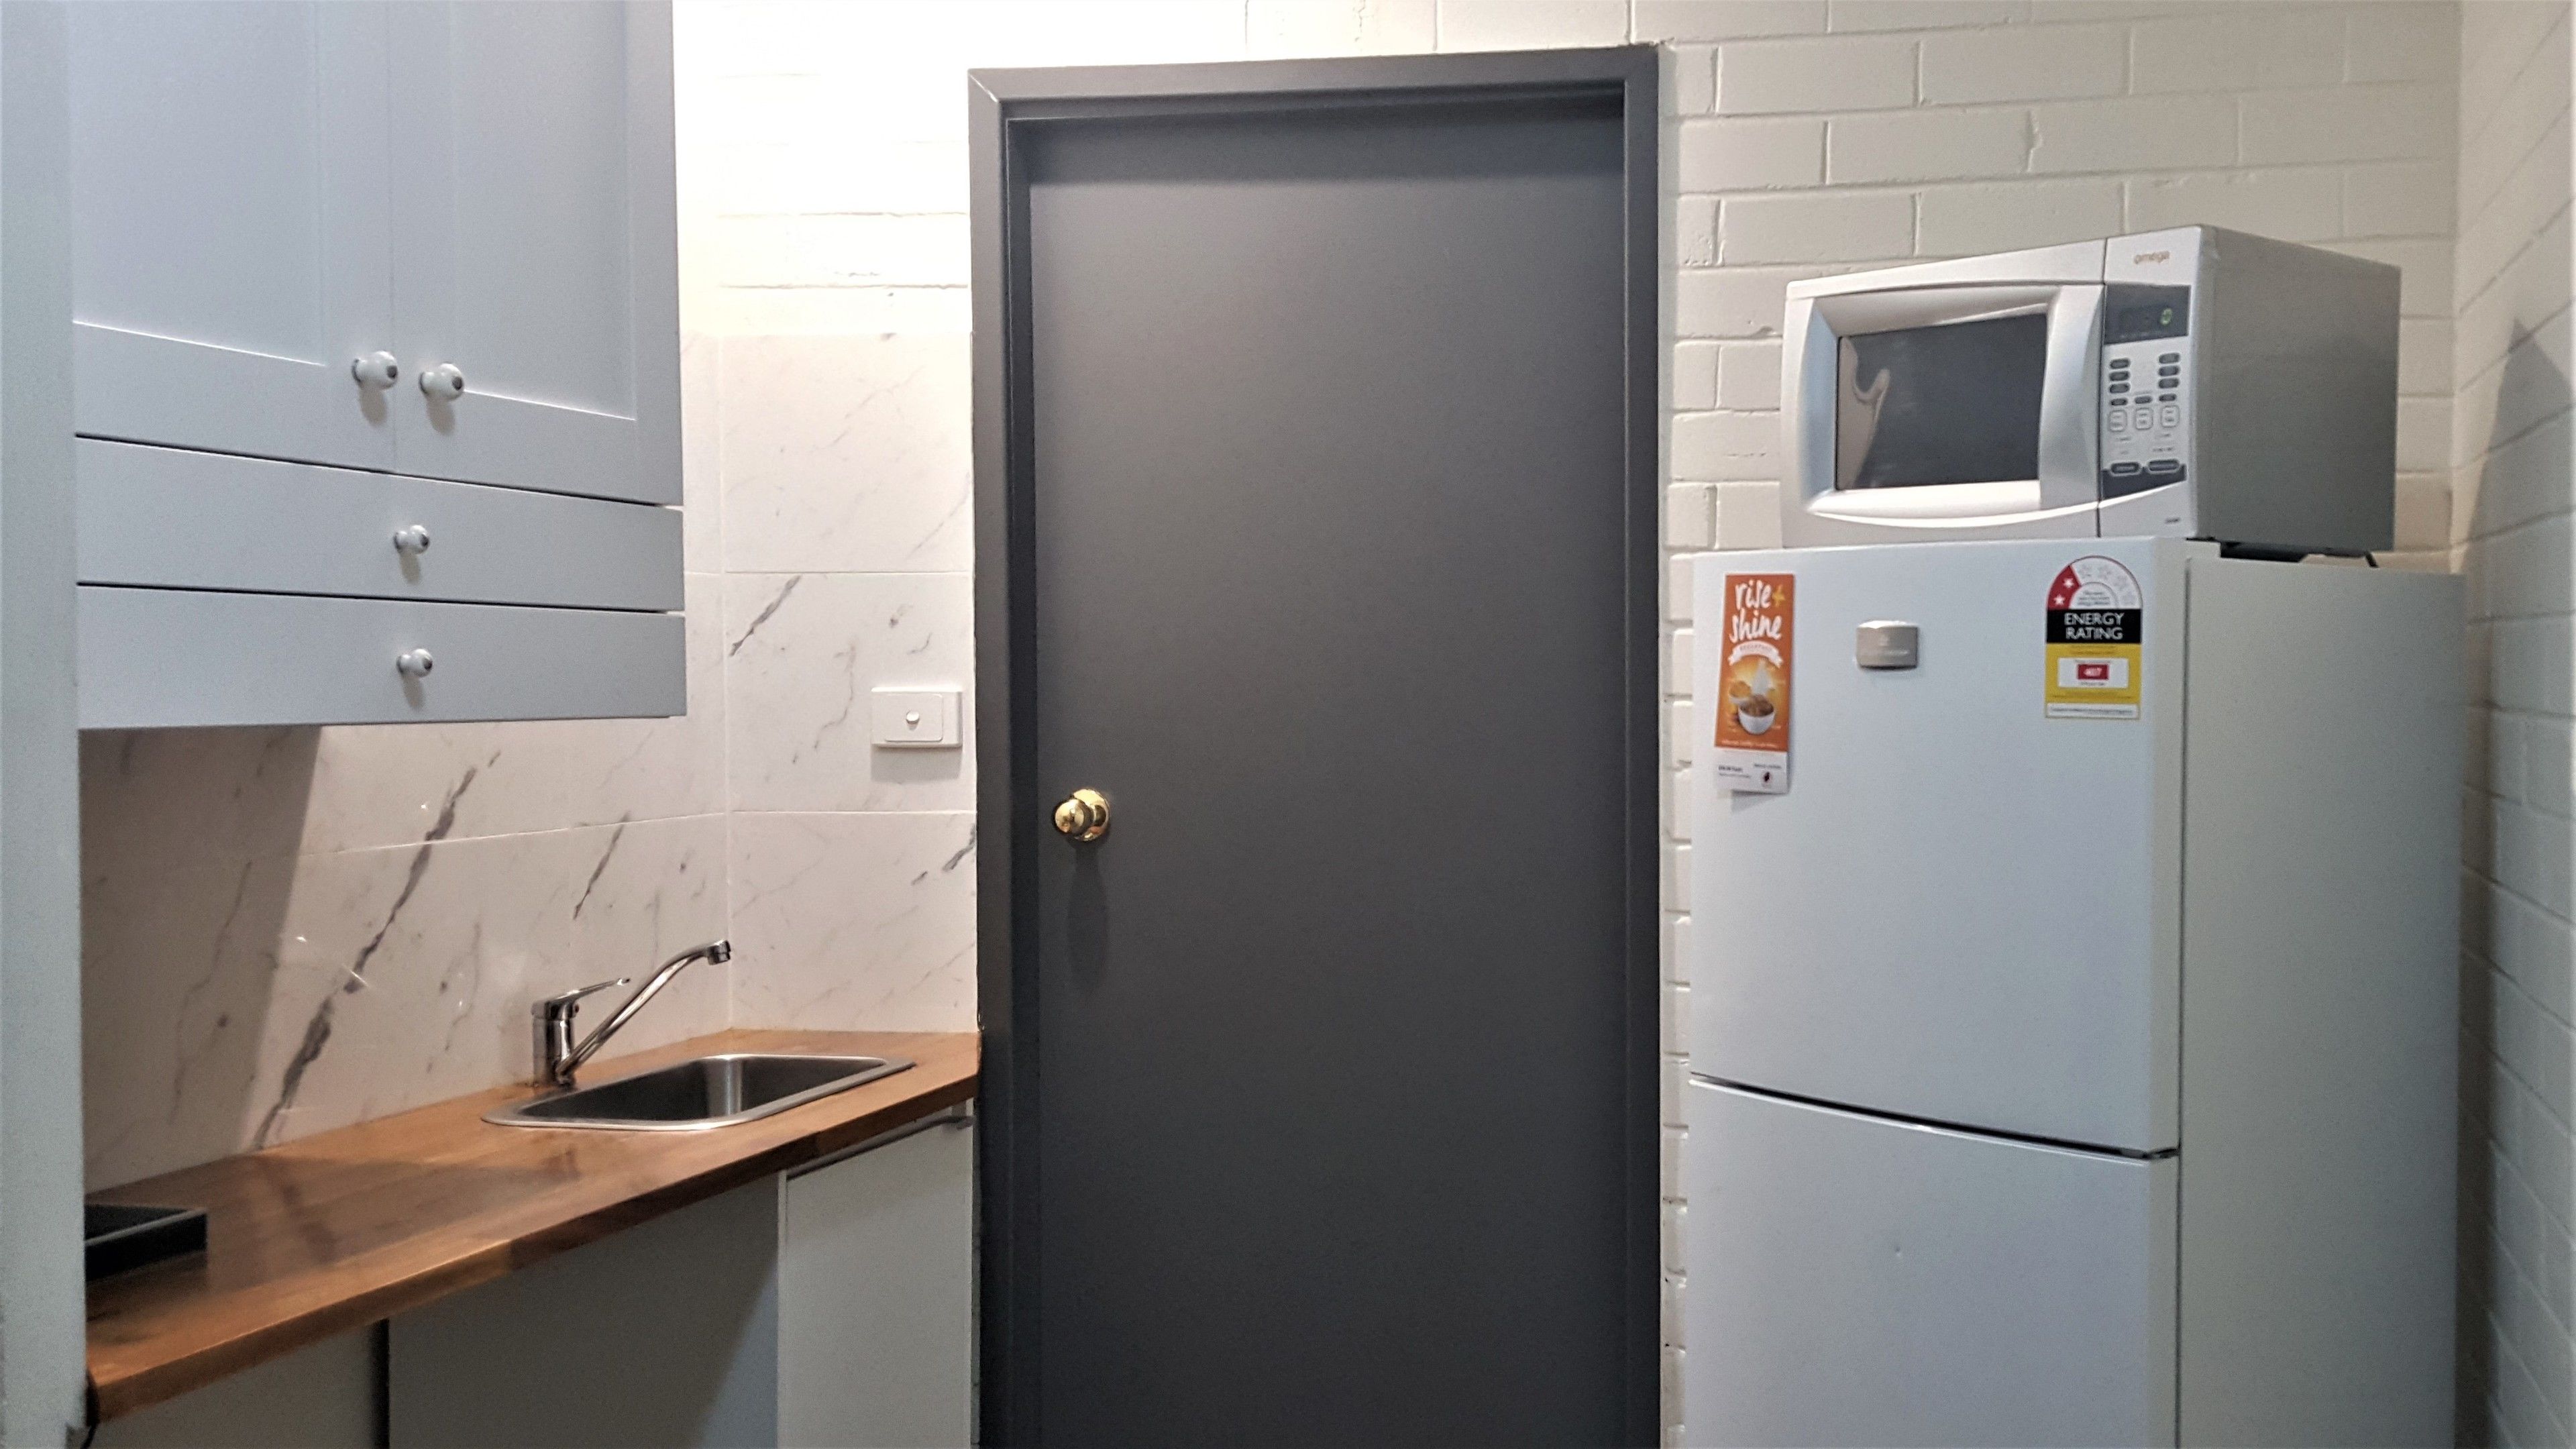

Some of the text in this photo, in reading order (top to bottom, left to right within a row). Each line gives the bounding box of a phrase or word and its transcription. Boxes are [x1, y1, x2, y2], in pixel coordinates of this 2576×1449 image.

[2064, 612, 2125, 625] ENERGY
[1729, 608, 1782, 643] shine
[2065, 627, 2123, 640] RATING
